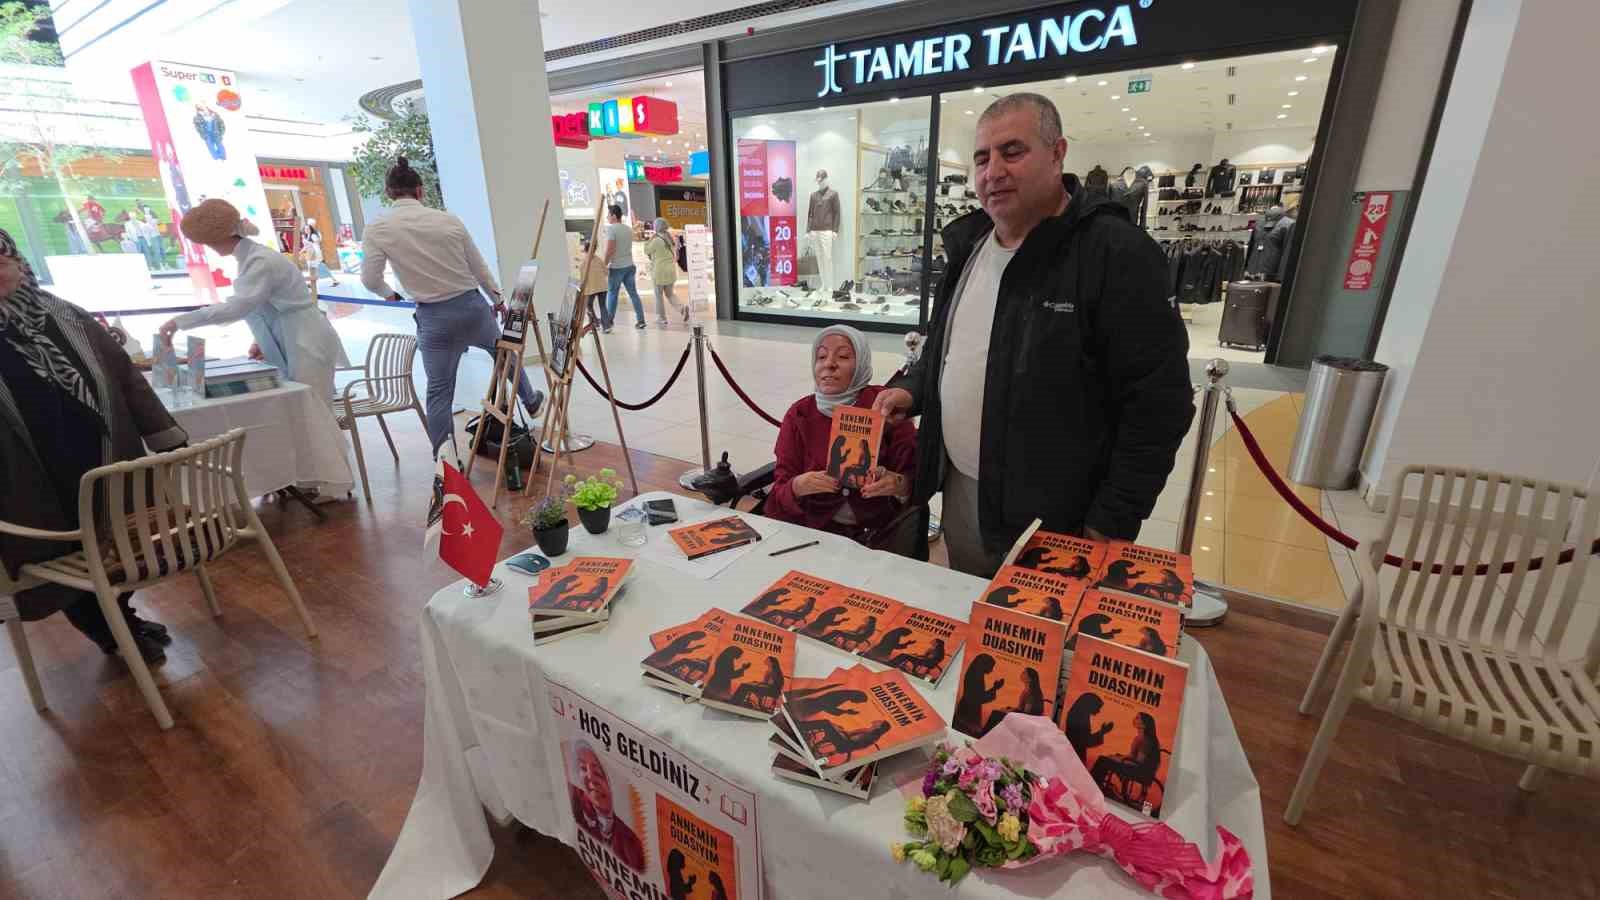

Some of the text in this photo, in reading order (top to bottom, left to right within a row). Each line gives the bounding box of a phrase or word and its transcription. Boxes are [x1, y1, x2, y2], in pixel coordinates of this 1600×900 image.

[850, 34, 971, 84] TAMER
[981, 5, 1137, 65] TANCA
[161, 66, 197, 80] Super
[775, 226, 791, 241] 20
[775, 260, 792, 274] 40
[732, 634, 782, 653] DUASIYIM
[984, 617, 1047, 646] ANNEMİN
[982, 632, 1044, 662] DUASIYIM
[1091, 653, 1165, 689] ANNEMİN
[1088, 670, 1162, 707] DUASIYIM
[579, 709, 701, 802] HOŞ GELDİNİZ
